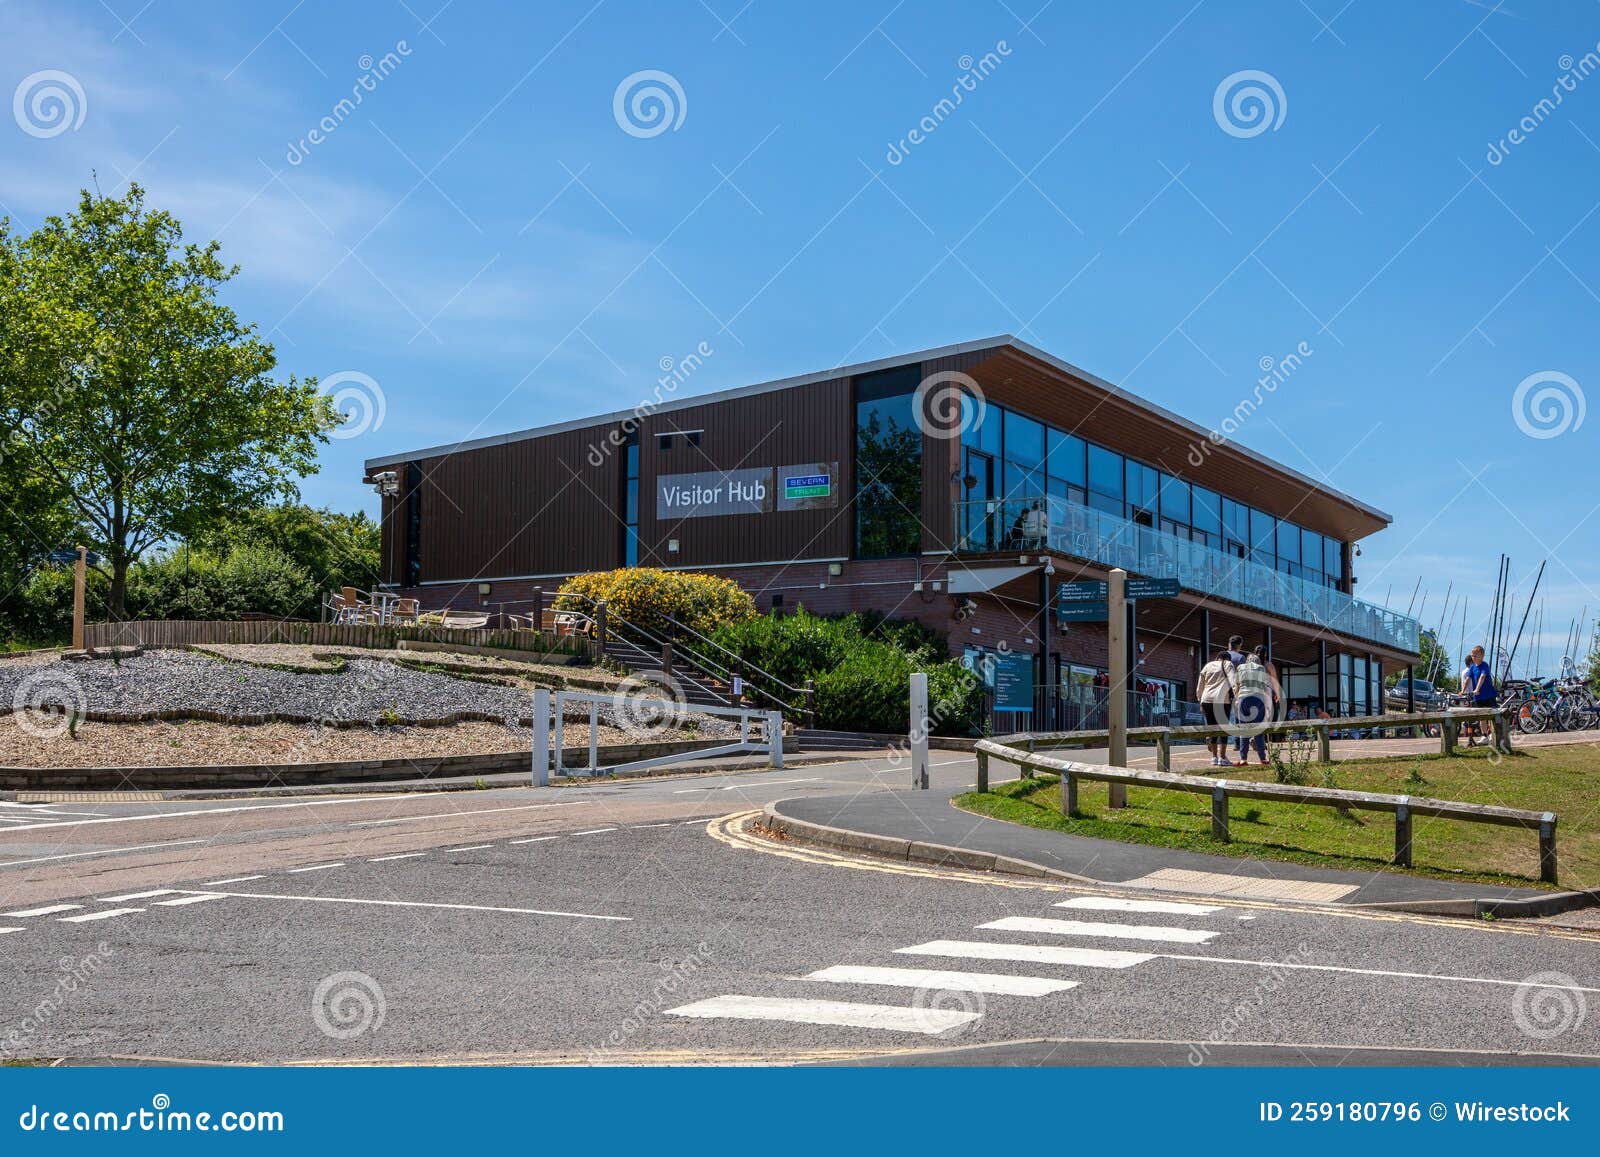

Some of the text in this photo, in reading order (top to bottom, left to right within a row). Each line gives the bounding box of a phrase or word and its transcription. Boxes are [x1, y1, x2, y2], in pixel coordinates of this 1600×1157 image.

[790, 477, 825, 486] SEVERN
[663, 479, 766, 507] Visitor Hub
